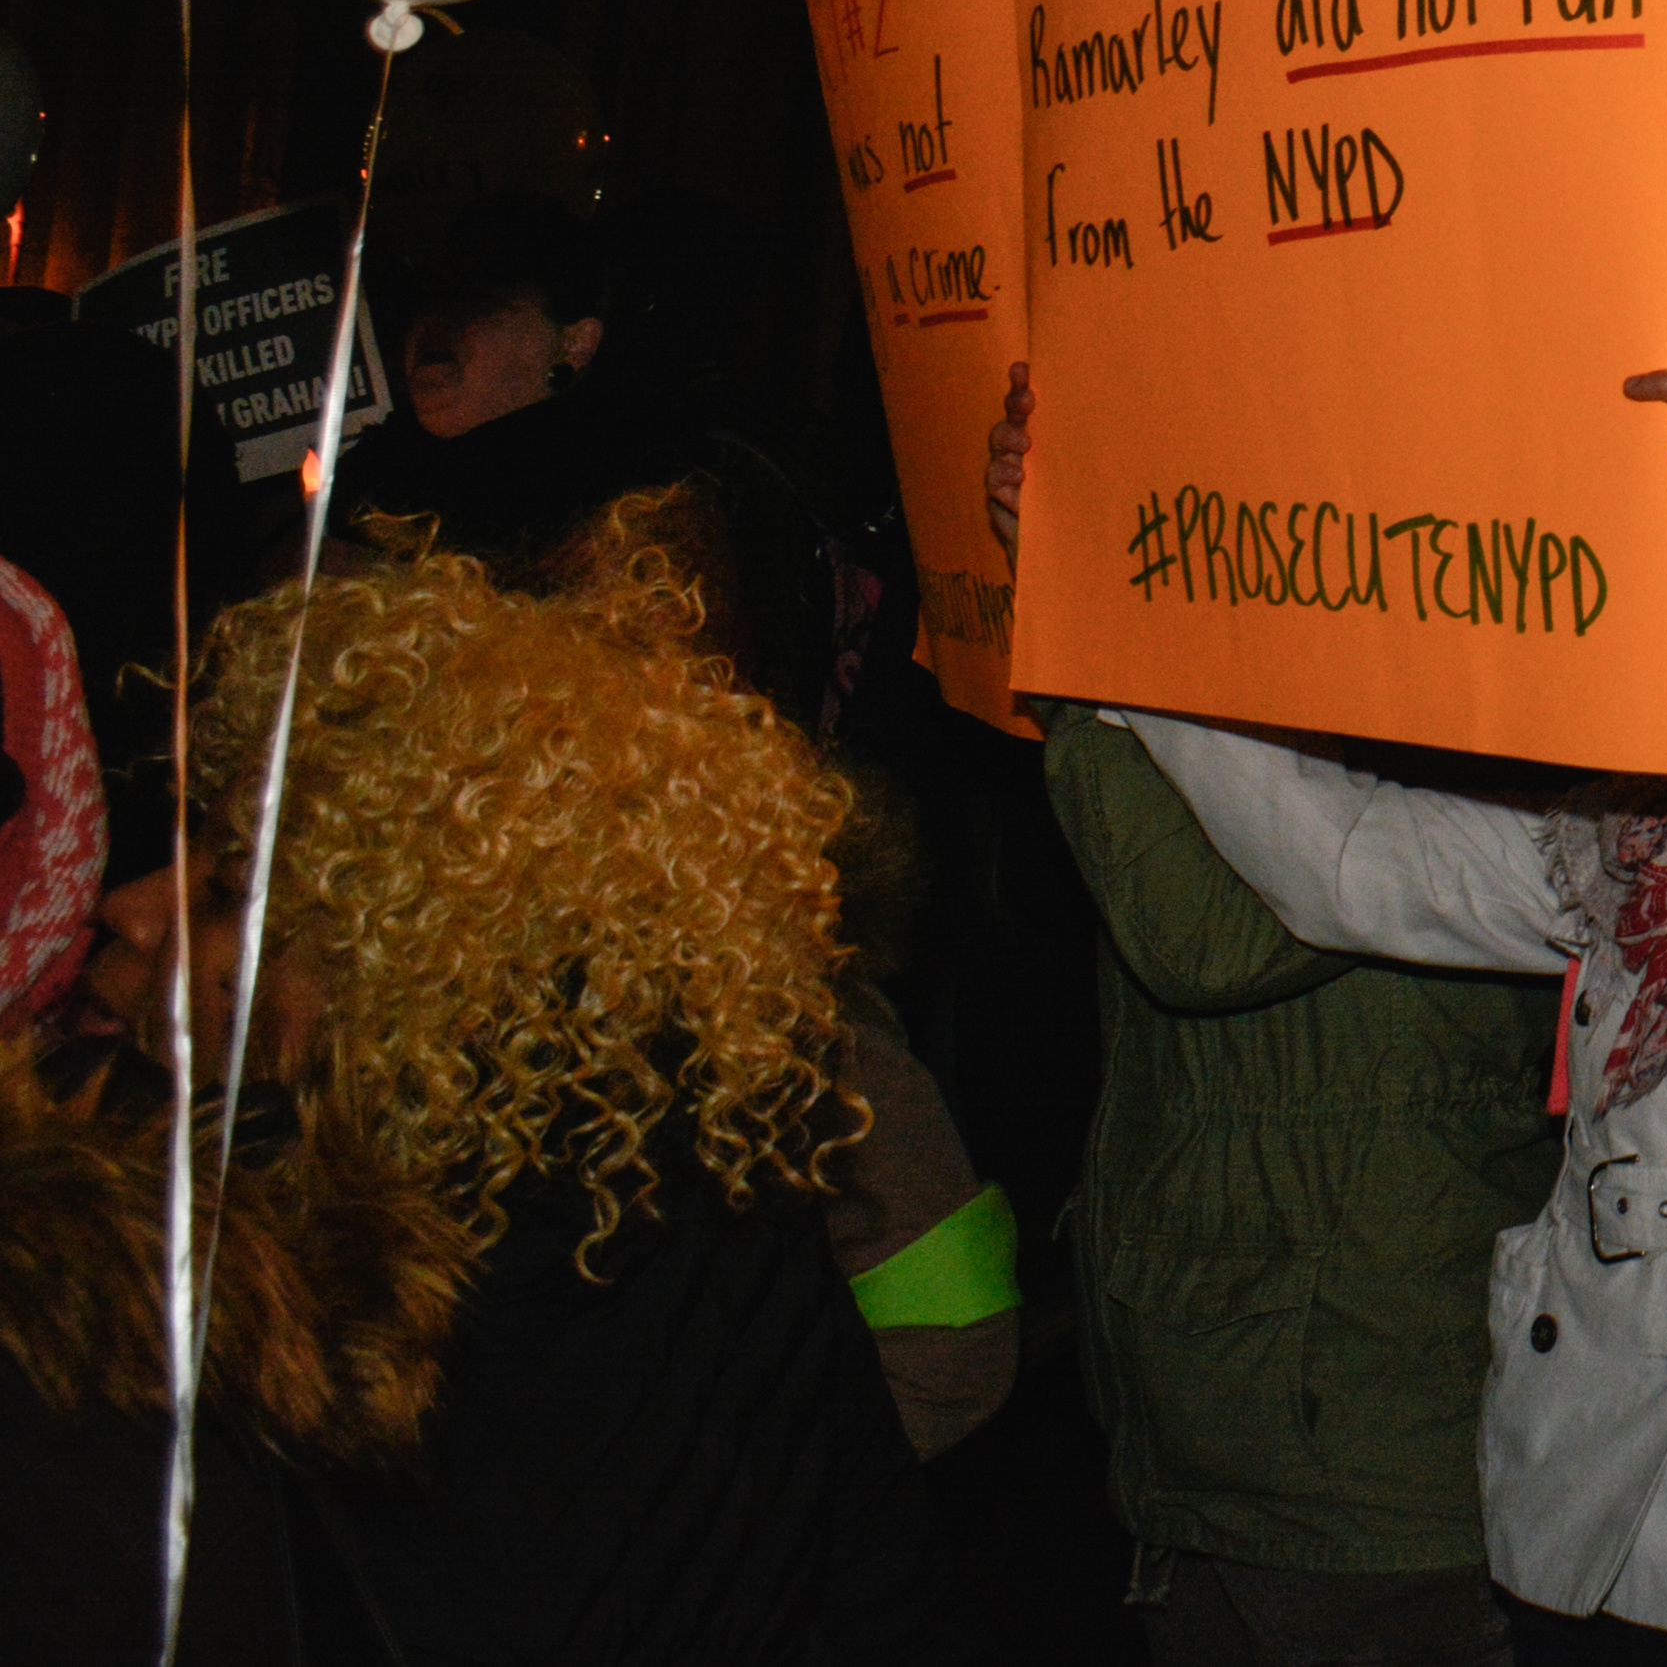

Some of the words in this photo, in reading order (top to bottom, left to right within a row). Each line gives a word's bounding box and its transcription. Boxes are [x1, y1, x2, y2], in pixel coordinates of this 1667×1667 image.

[899, 54, 952, 177] not
[1045, 163, 1134, 270] from
[1157, 137, 1223, 251] the
[1263, 123, 1404, 230] NYPD
[164, 247, 231, 299] FRE
[203, 273, 335, 336] OFFICERS
[195, 334, 295, 388] KILLED
[1127, 484, 1607, 637] #PROSECUTENYPD
